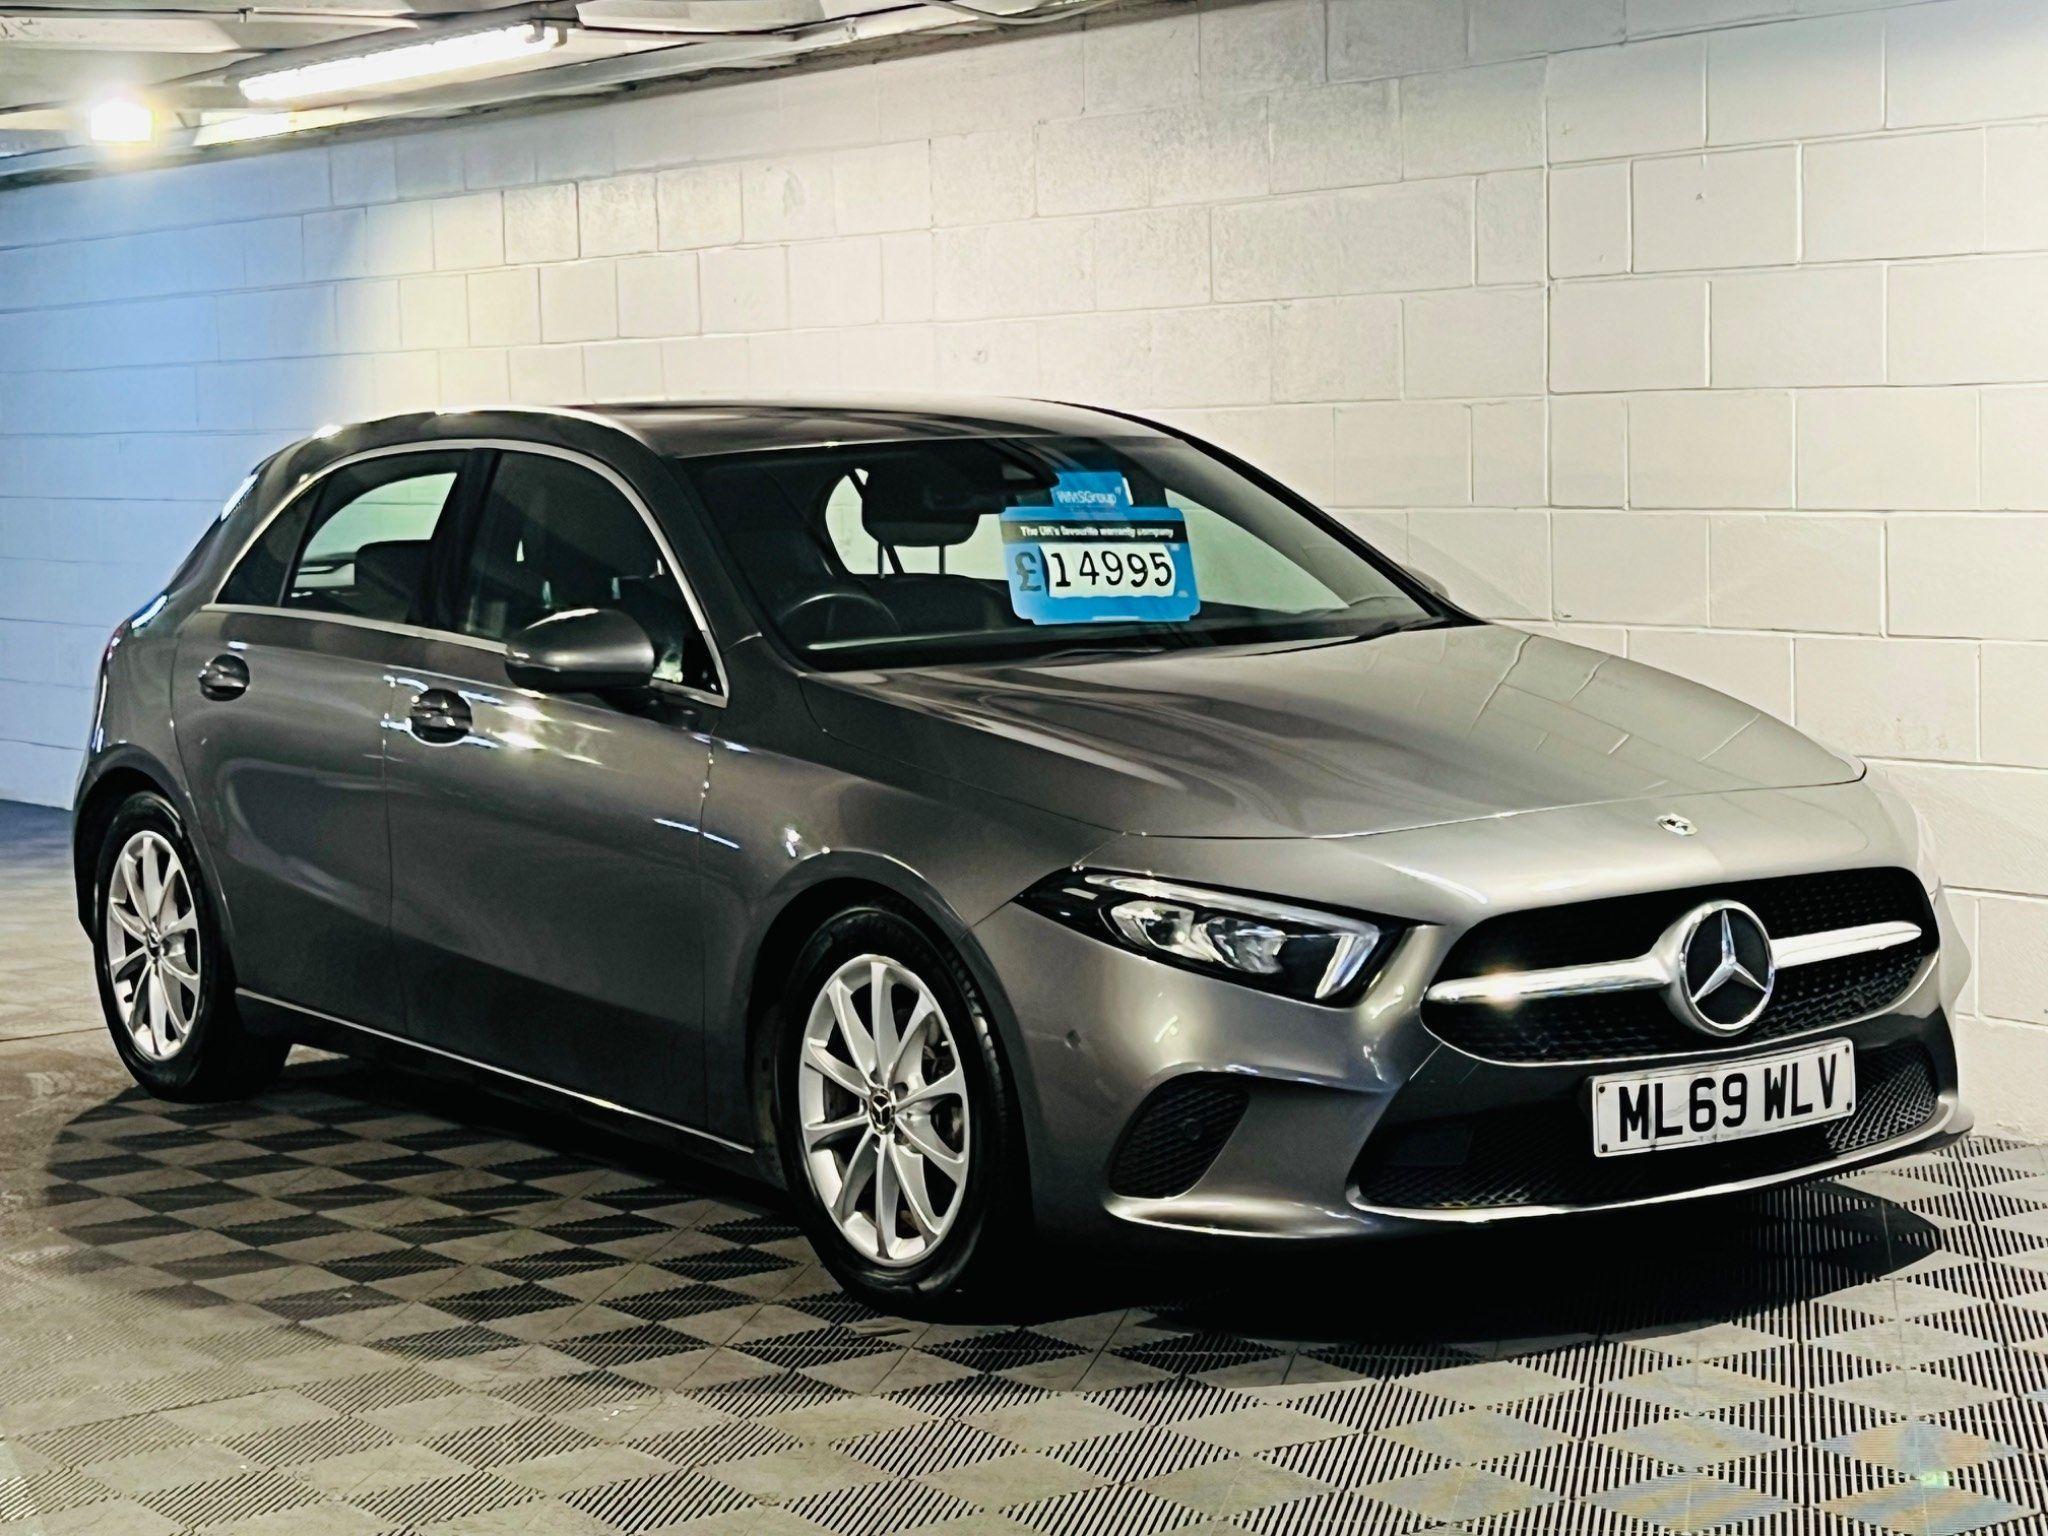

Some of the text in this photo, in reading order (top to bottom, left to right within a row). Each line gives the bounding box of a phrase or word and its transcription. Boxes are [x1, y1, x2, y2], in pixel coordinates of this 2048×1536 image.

[1020, 526, 1038, 536] The
[1618, 1053, 1837, 1142] ML69 WLV
